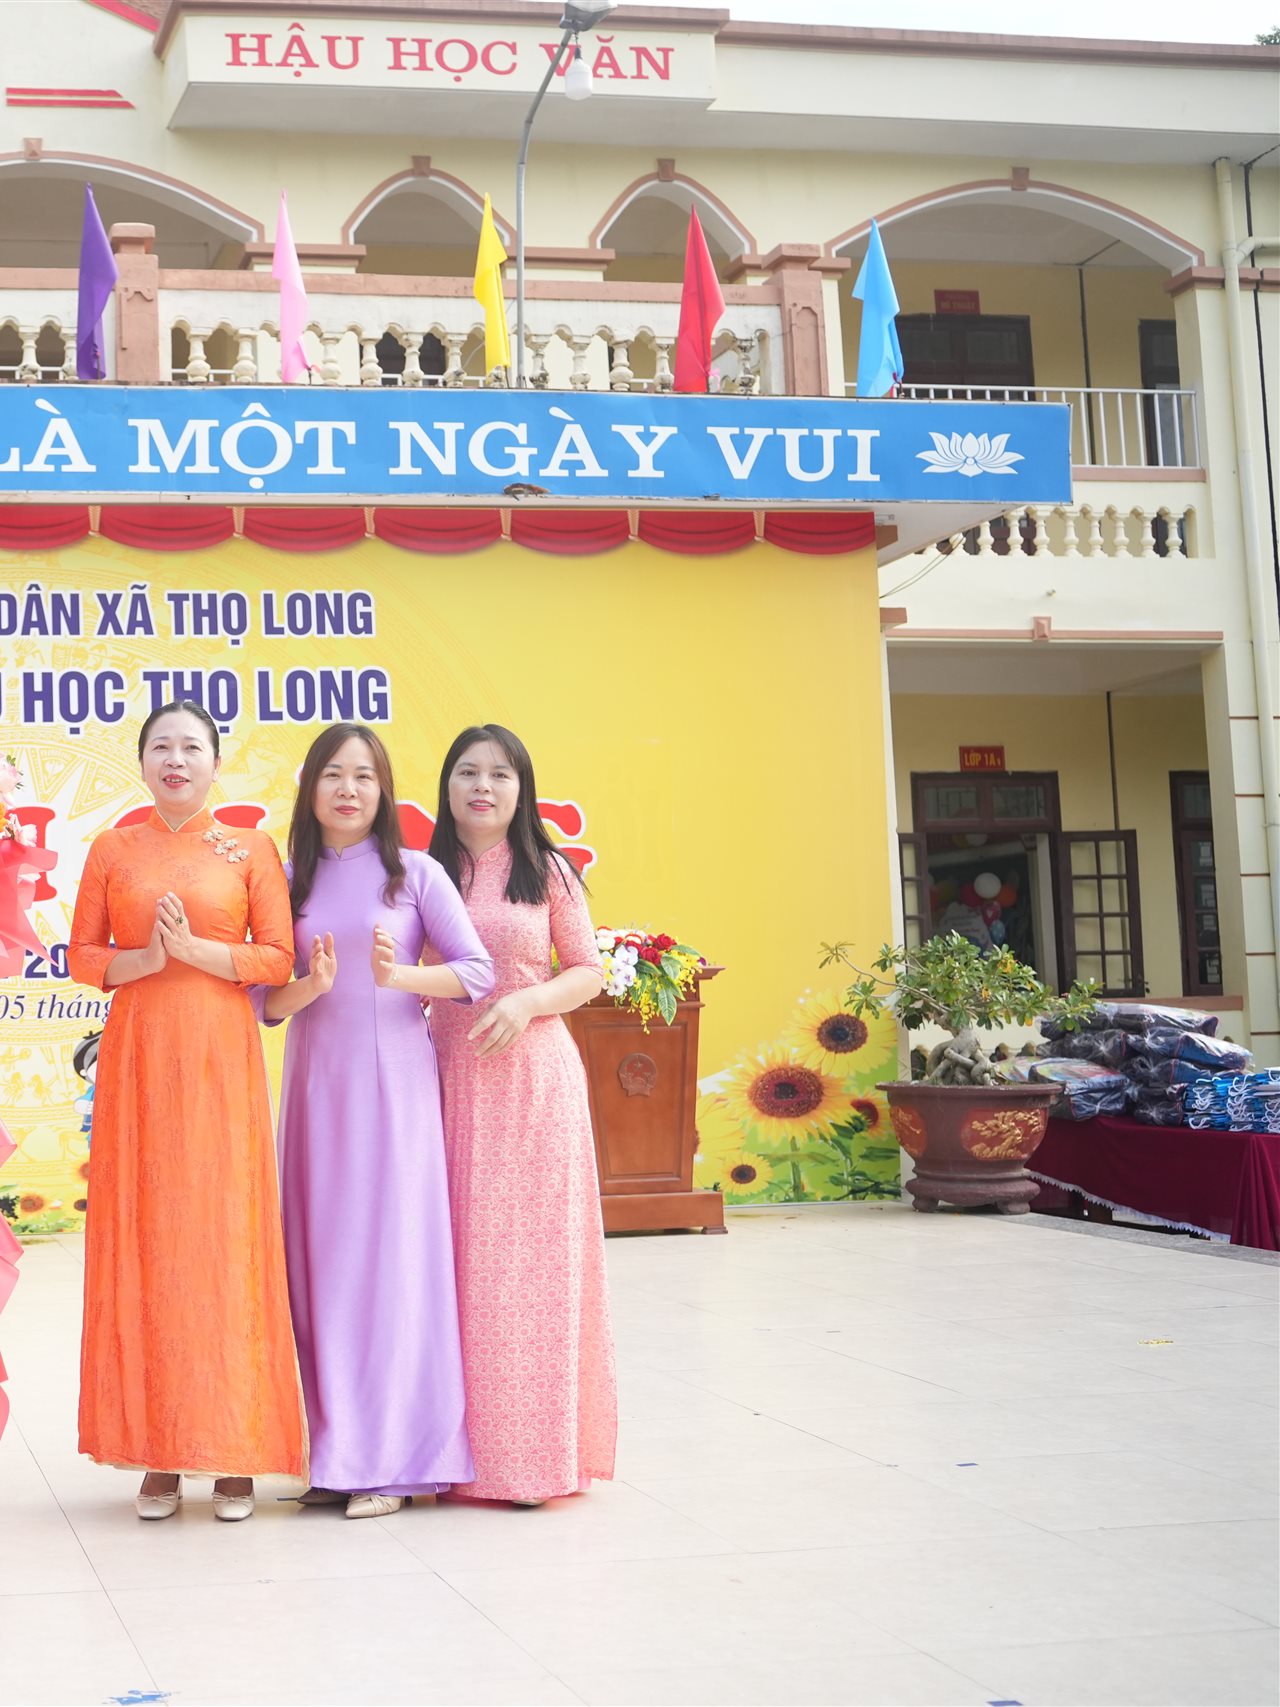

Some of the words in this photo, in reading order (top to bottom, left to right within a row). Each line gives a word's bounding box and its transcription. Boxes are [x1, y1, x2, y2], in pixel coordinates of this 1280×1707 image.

[225, 22, 364, 77] HẬU
[387, 37, 517, 83] HỌC
[539, 35, 675, 81] VĂN
[128, 403, 357, 489] MỘT
[388, 407, 678, 480] NGÀY
[707, 426, 880, 482] VUI
[96, 583, 154, 637] XÃ
[167, 593, 248, 645] THỌ
[264, 592, 374, 636] LONG
[22, 670, 125, 734] HỌC
[142, 670, 239, 733] THỌ
[258, 670, 389, 722] LONG
